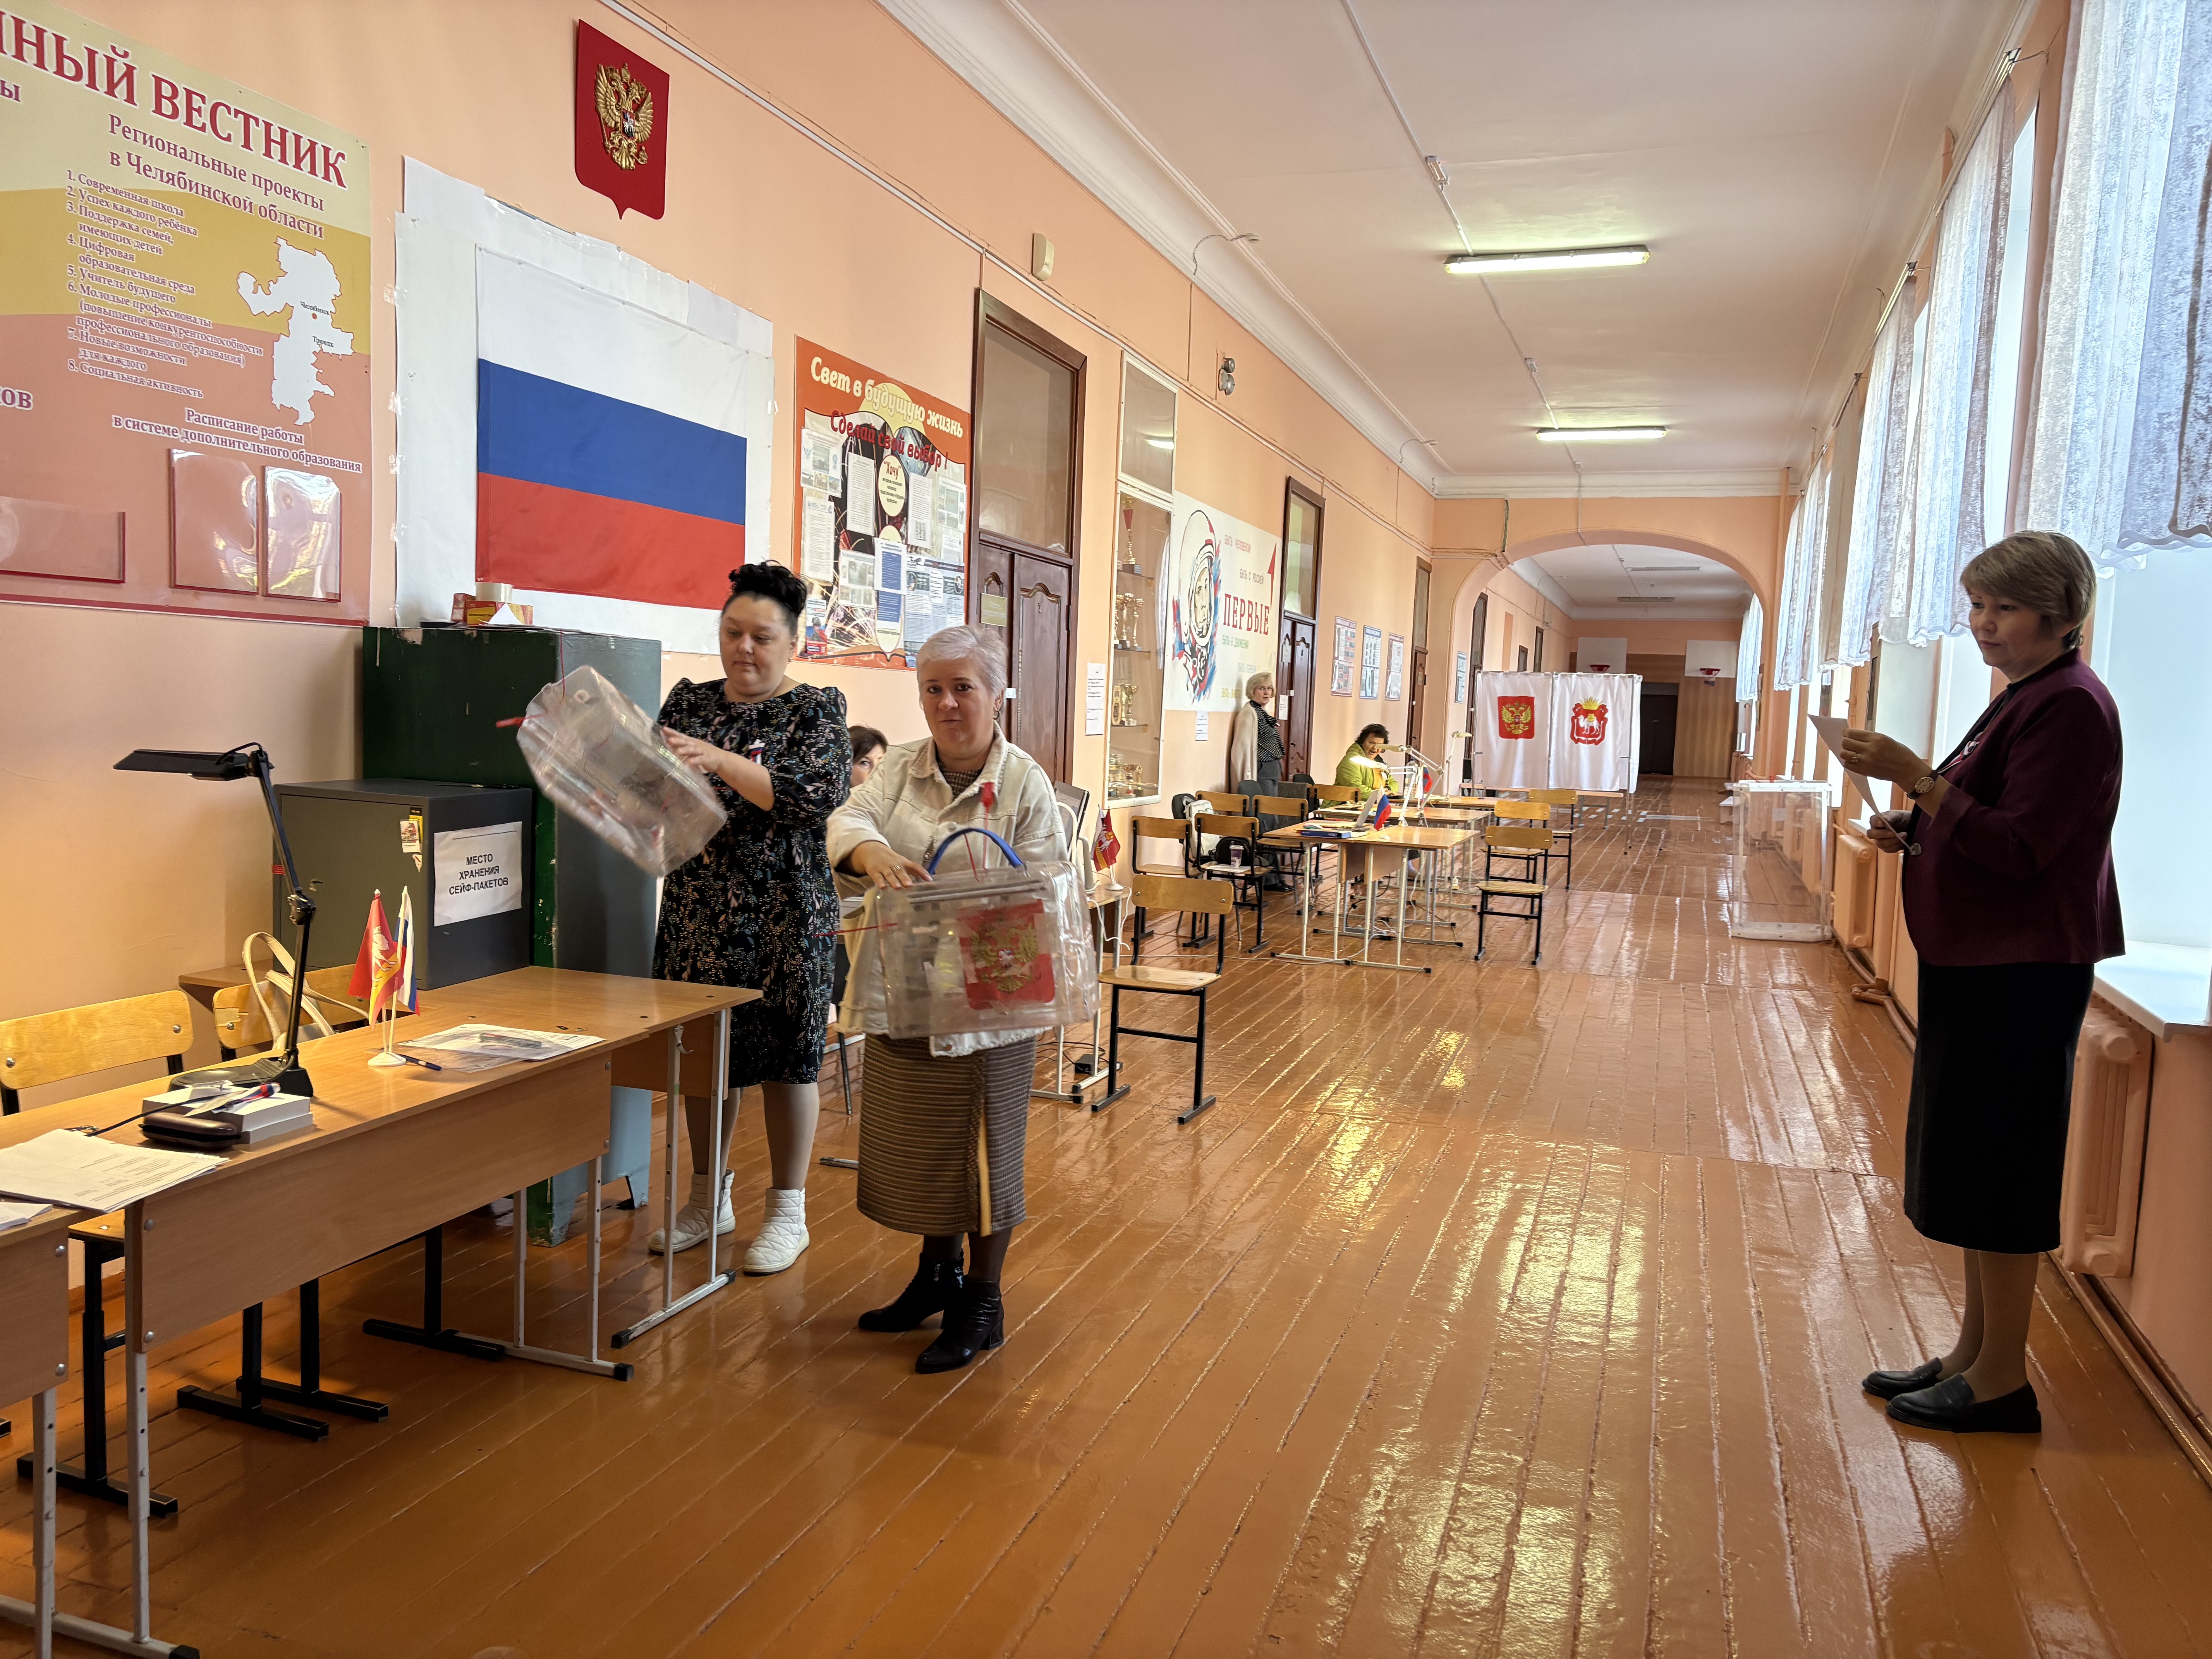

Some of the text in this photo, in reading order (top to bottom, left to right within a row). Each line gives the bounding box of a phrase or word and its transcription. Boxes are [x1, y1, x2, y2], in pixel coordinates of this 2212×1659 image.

[151, 74, 347, 188] ВЕСТНИК
[109, 114, 324, 211] Региональные проекты
[66, 185, 198, 236] 2. Успех каждого ребёнка
[67, 170, 184, 216] 1. Современная школа
[109, 151, 324, 239] в Челябинской области
[67, 202, 173, 244] 3. Поддержка семей,
[79, 223, 162, 254] имеющих детей
[67, 234, 135, 261] 4. Цифровая
[68, 265, 175, 303] 5. Учитель будущего
[79, 255, 195, 294] образовательная среда
[68, 282, 212, 328] 6. Молодые профессионалы
[77, 317, 245, 367] профессионального образования)
[79, 330, 115, 347] Новые
[118, 344, 186, 364] возможности
[80, 300, 263, 355] (повышение конкурентоспособности
[69, 360, 203, 398] 8. Социальная активность
[79, 349, 146, 370] для каждого
[0, 389, 31, 409] ов
[811, 357, 963, 438] Свет в будущую жизнь
[114, 417, 361, 472] в системе дополнительного образования
[186, 409, 303, 444] Расписание работы
[831, 410, 875, 444] Сделай
[878, 432, 904, 455] свой
[1223, 593, 1269, 635] ПЕРВЫЕ
[459, 866, 499, 880] ХРАНЕНИЯ
[466, 854, 493, 865] МЕСТО
[449, 877, 508, 895] СЕЙФ-ПАКЕТОВ
